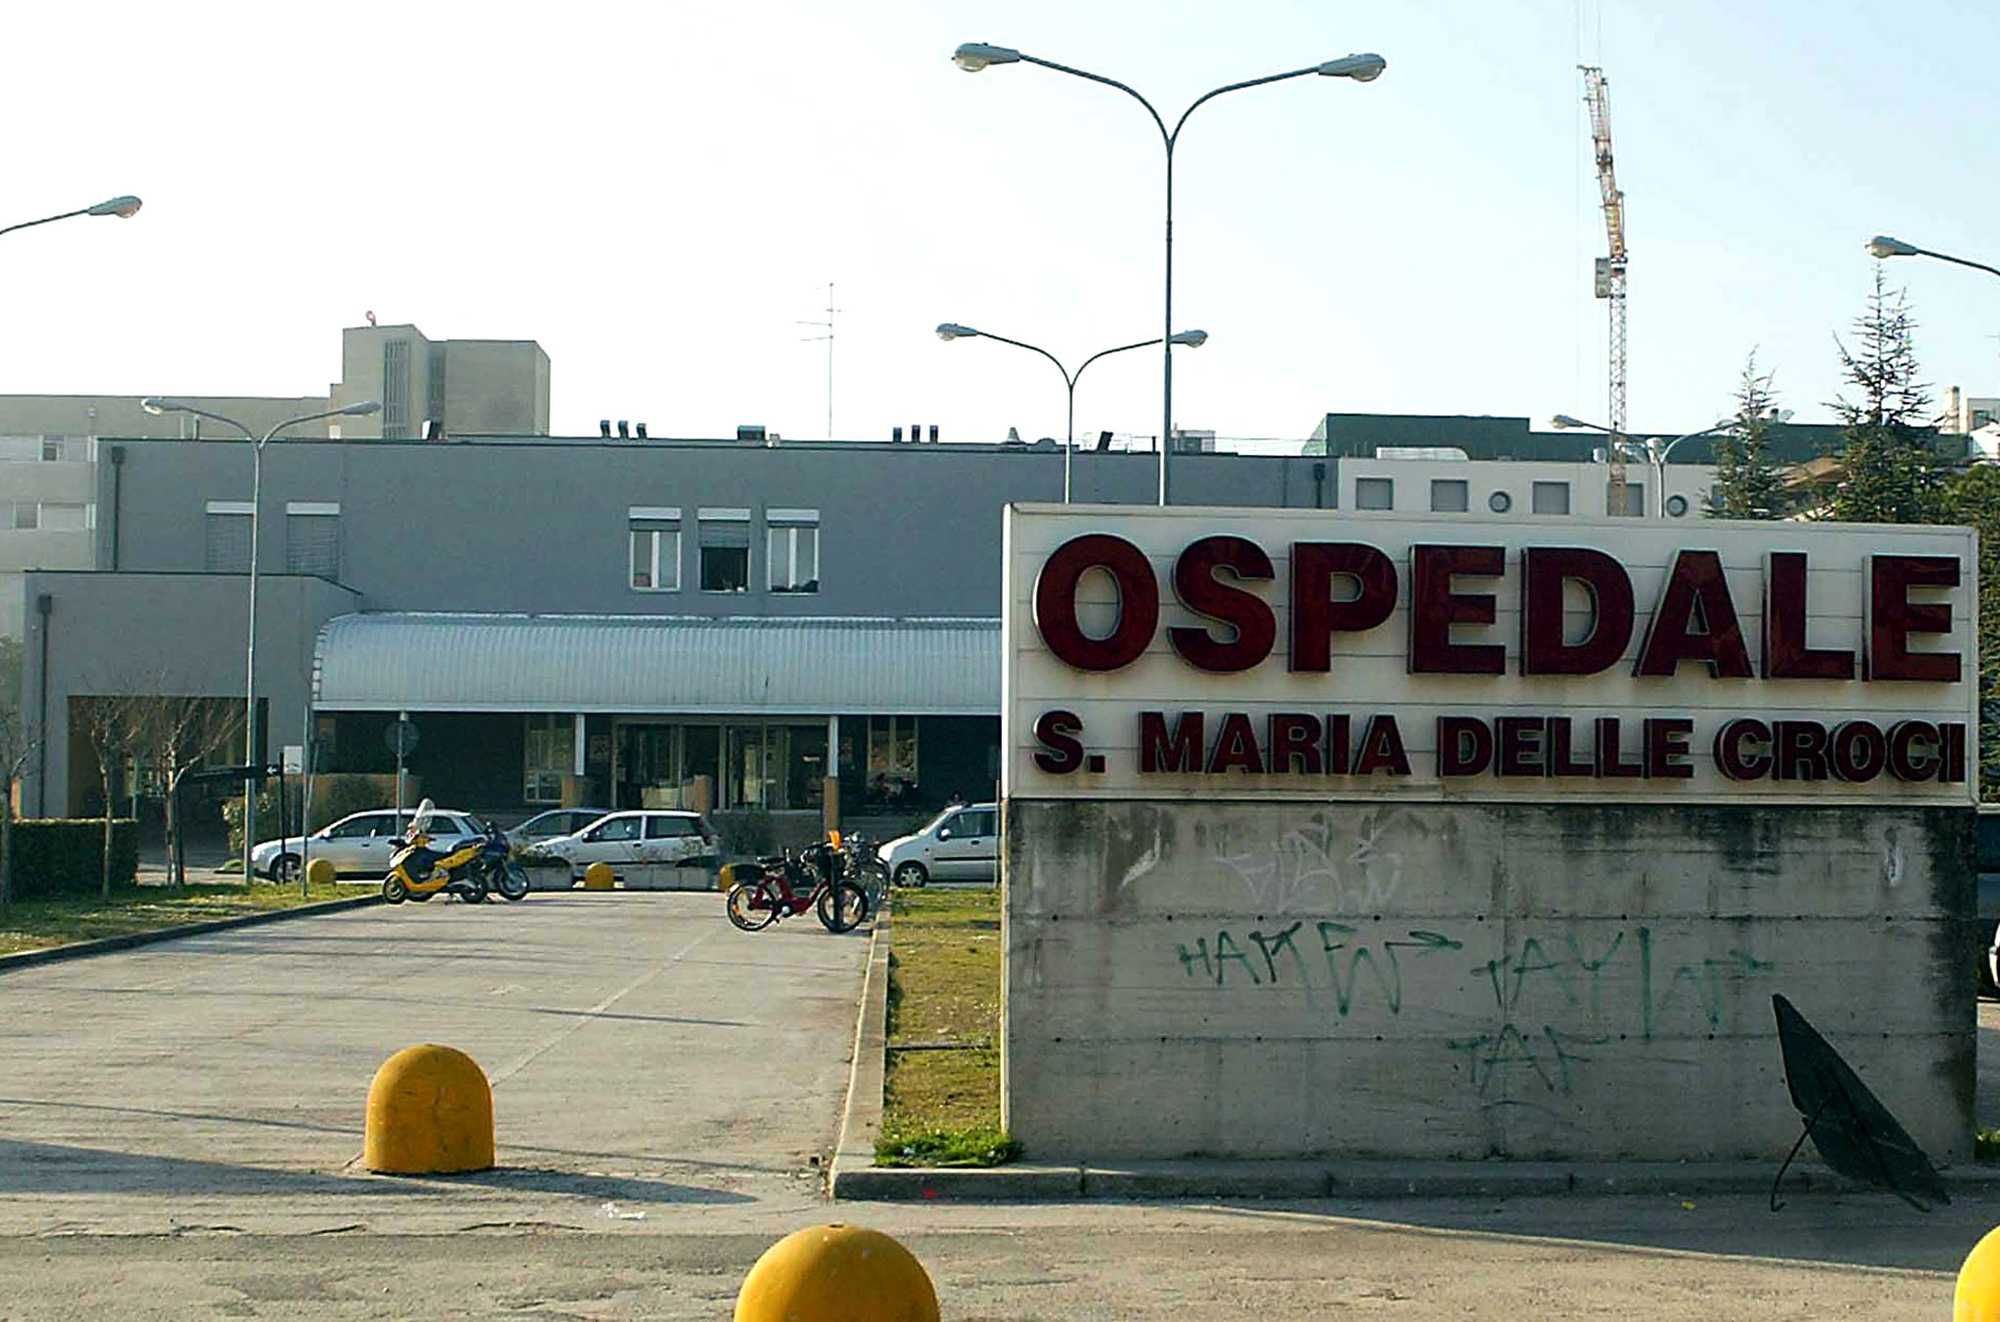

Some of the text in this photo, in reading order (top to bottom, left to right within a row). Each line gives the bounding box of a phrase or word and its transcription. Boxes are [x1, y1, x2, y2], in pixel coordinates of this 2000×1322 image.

[1033, 533, 1962, 682] OSPEDALE
[1034, 710, 1966, 783] S. MARIA DELLE CROCI
